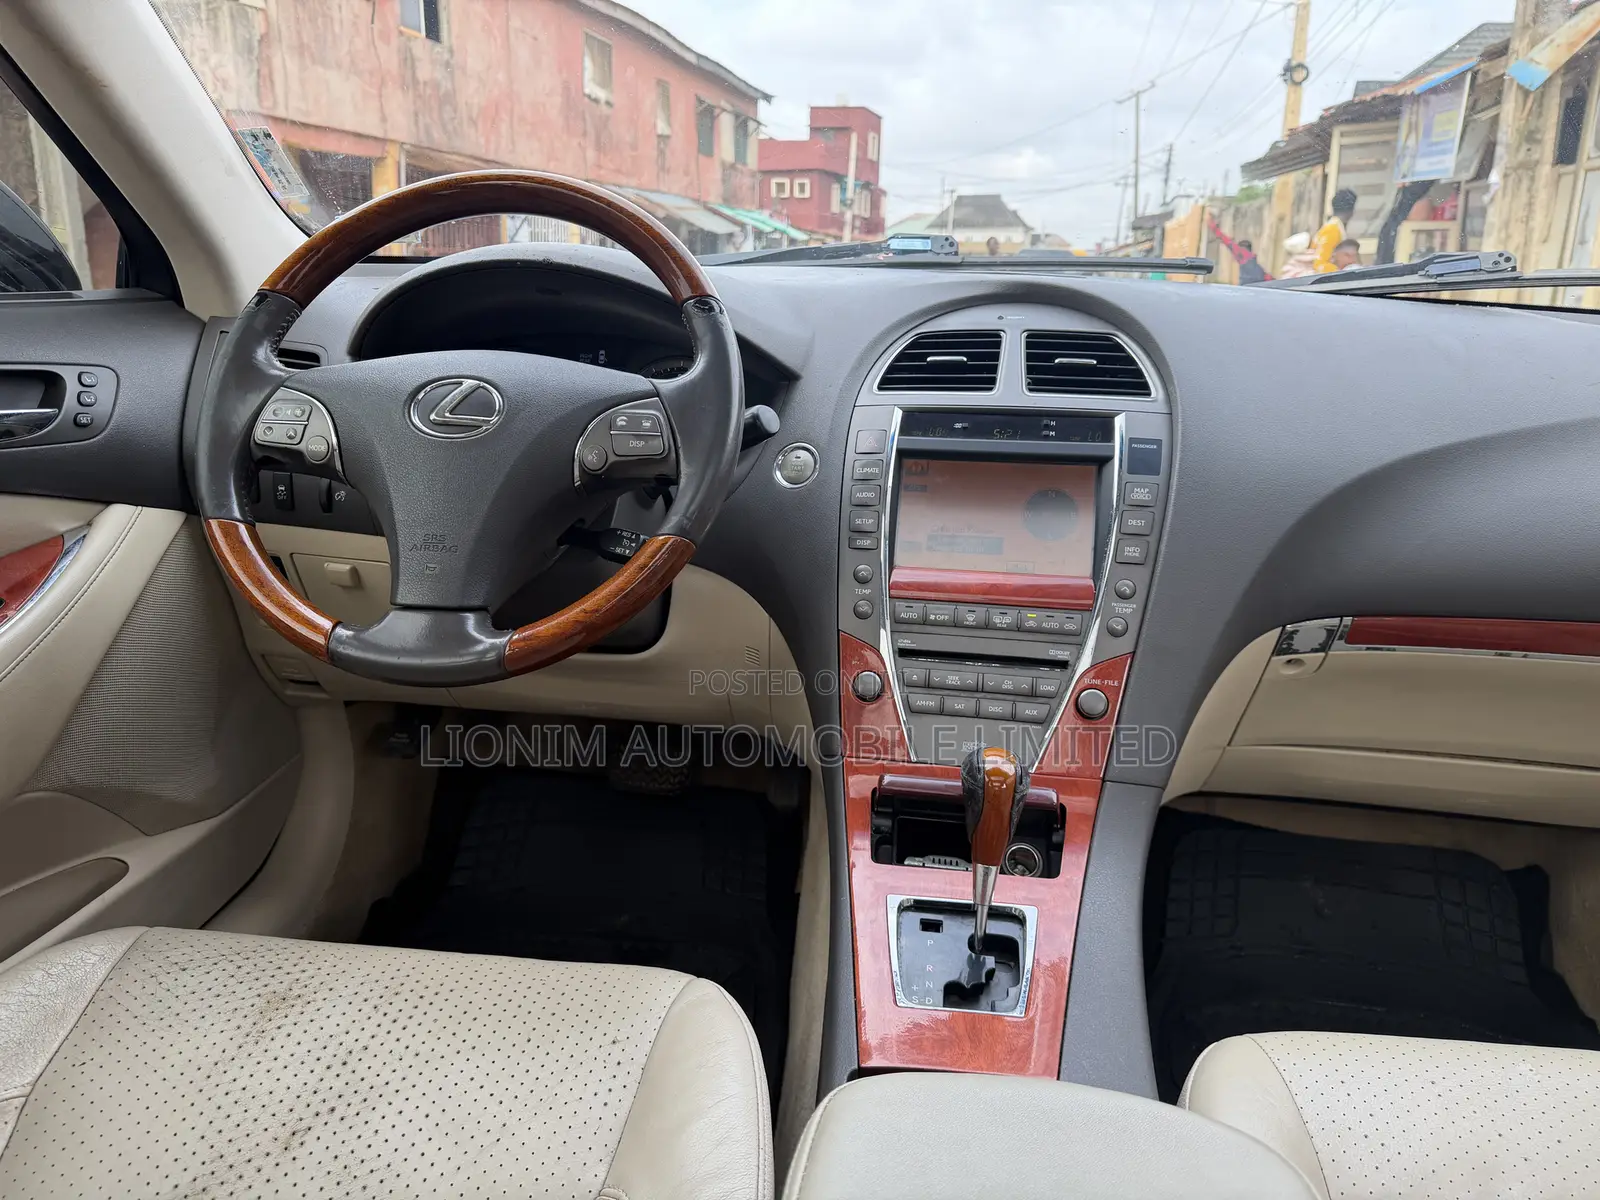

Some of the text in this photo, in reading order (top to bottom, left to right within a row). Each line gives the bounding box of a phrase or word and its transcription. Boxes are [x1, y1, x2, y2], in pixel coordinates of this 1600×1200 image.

[629, 440, 646, 448] DISP
[308, 445, 327, 453] MODE
[856, 491, 876, 499] AUDIO
[855, 517, 875, 525] SETUP
[1128, 519, 1146, 527] DEST
[423, 533, 448, 542] SRS
[409, 544, 460, 554] AIRBAG
[900, 611, 918, 619] AUTO
[1115, 607, 1133, 615] TEMP
[1041, 622, 1060, 630] AUTO
[1040, 683, 1056, 692] LOAD
[926, 964, 933, 972] R
